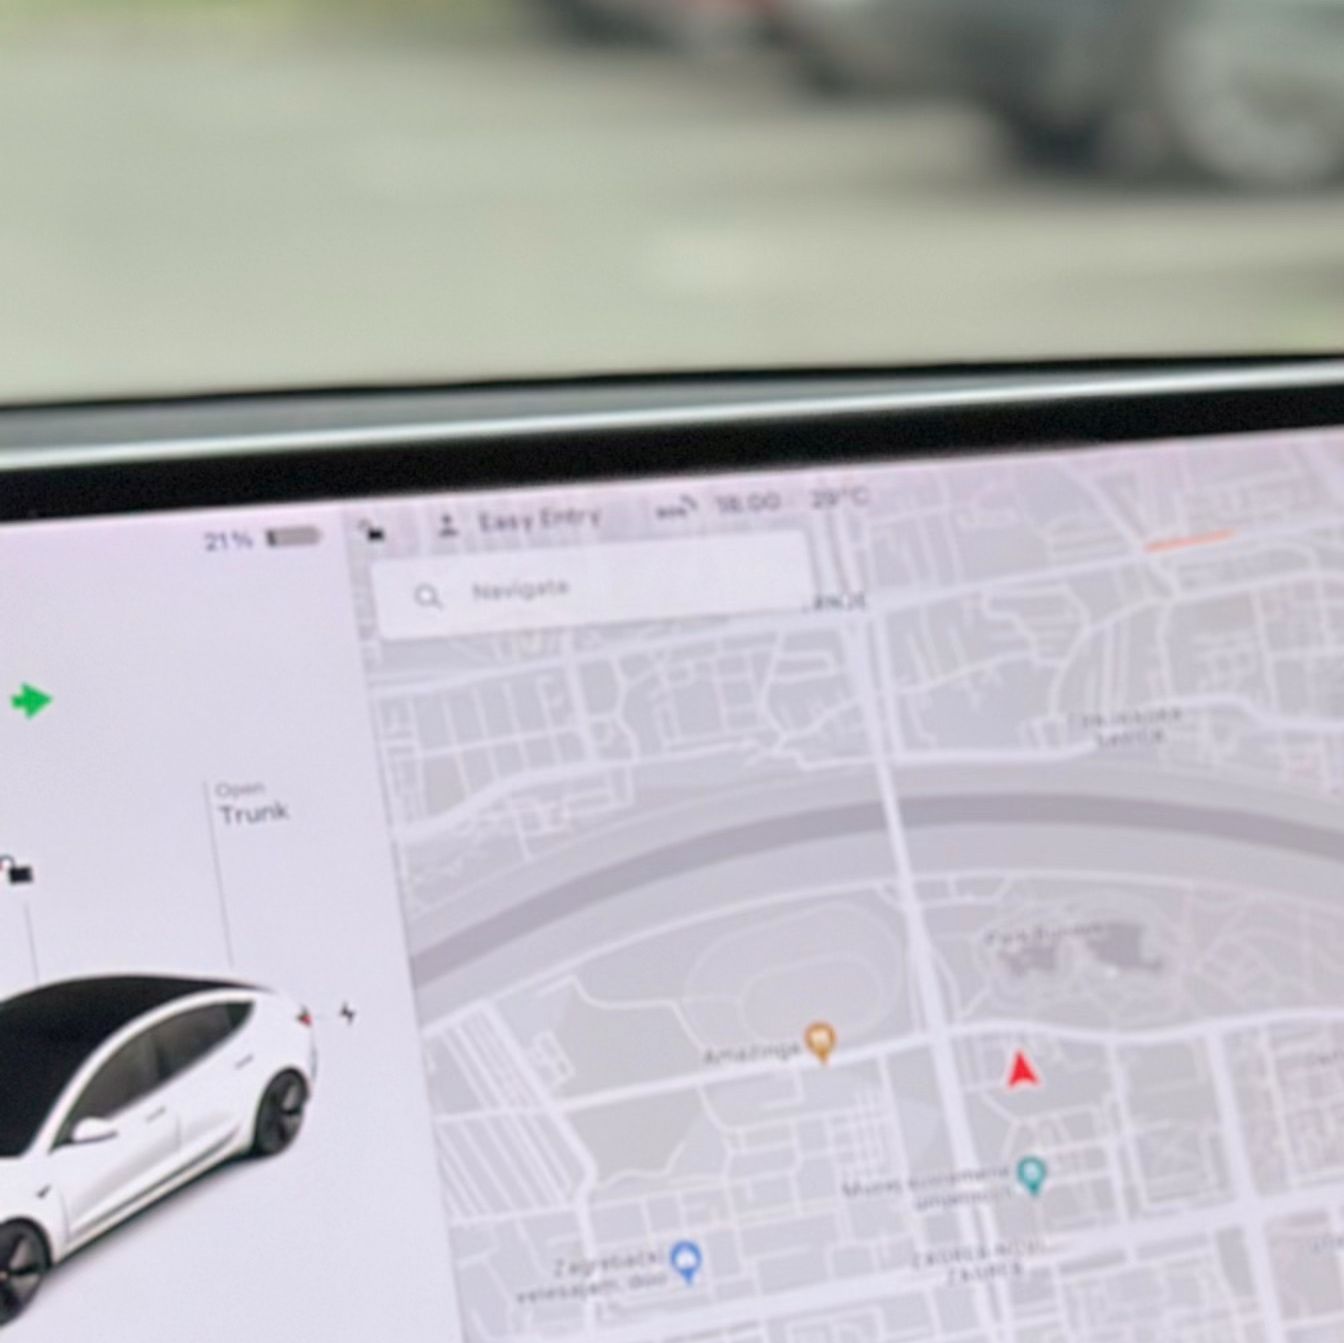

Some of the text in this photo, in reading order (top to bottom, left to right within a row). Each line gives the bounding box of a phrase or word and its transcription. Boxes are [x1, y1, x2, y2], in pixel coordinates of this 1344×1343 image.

[478, 506, 603, 535] Easy Entry
[204, 530, 253, 552] 21%
[472, 576, 569, 602] Navigate
[214, 781, 266, 800] Open
[219, 800, 290, 825] Trunk
